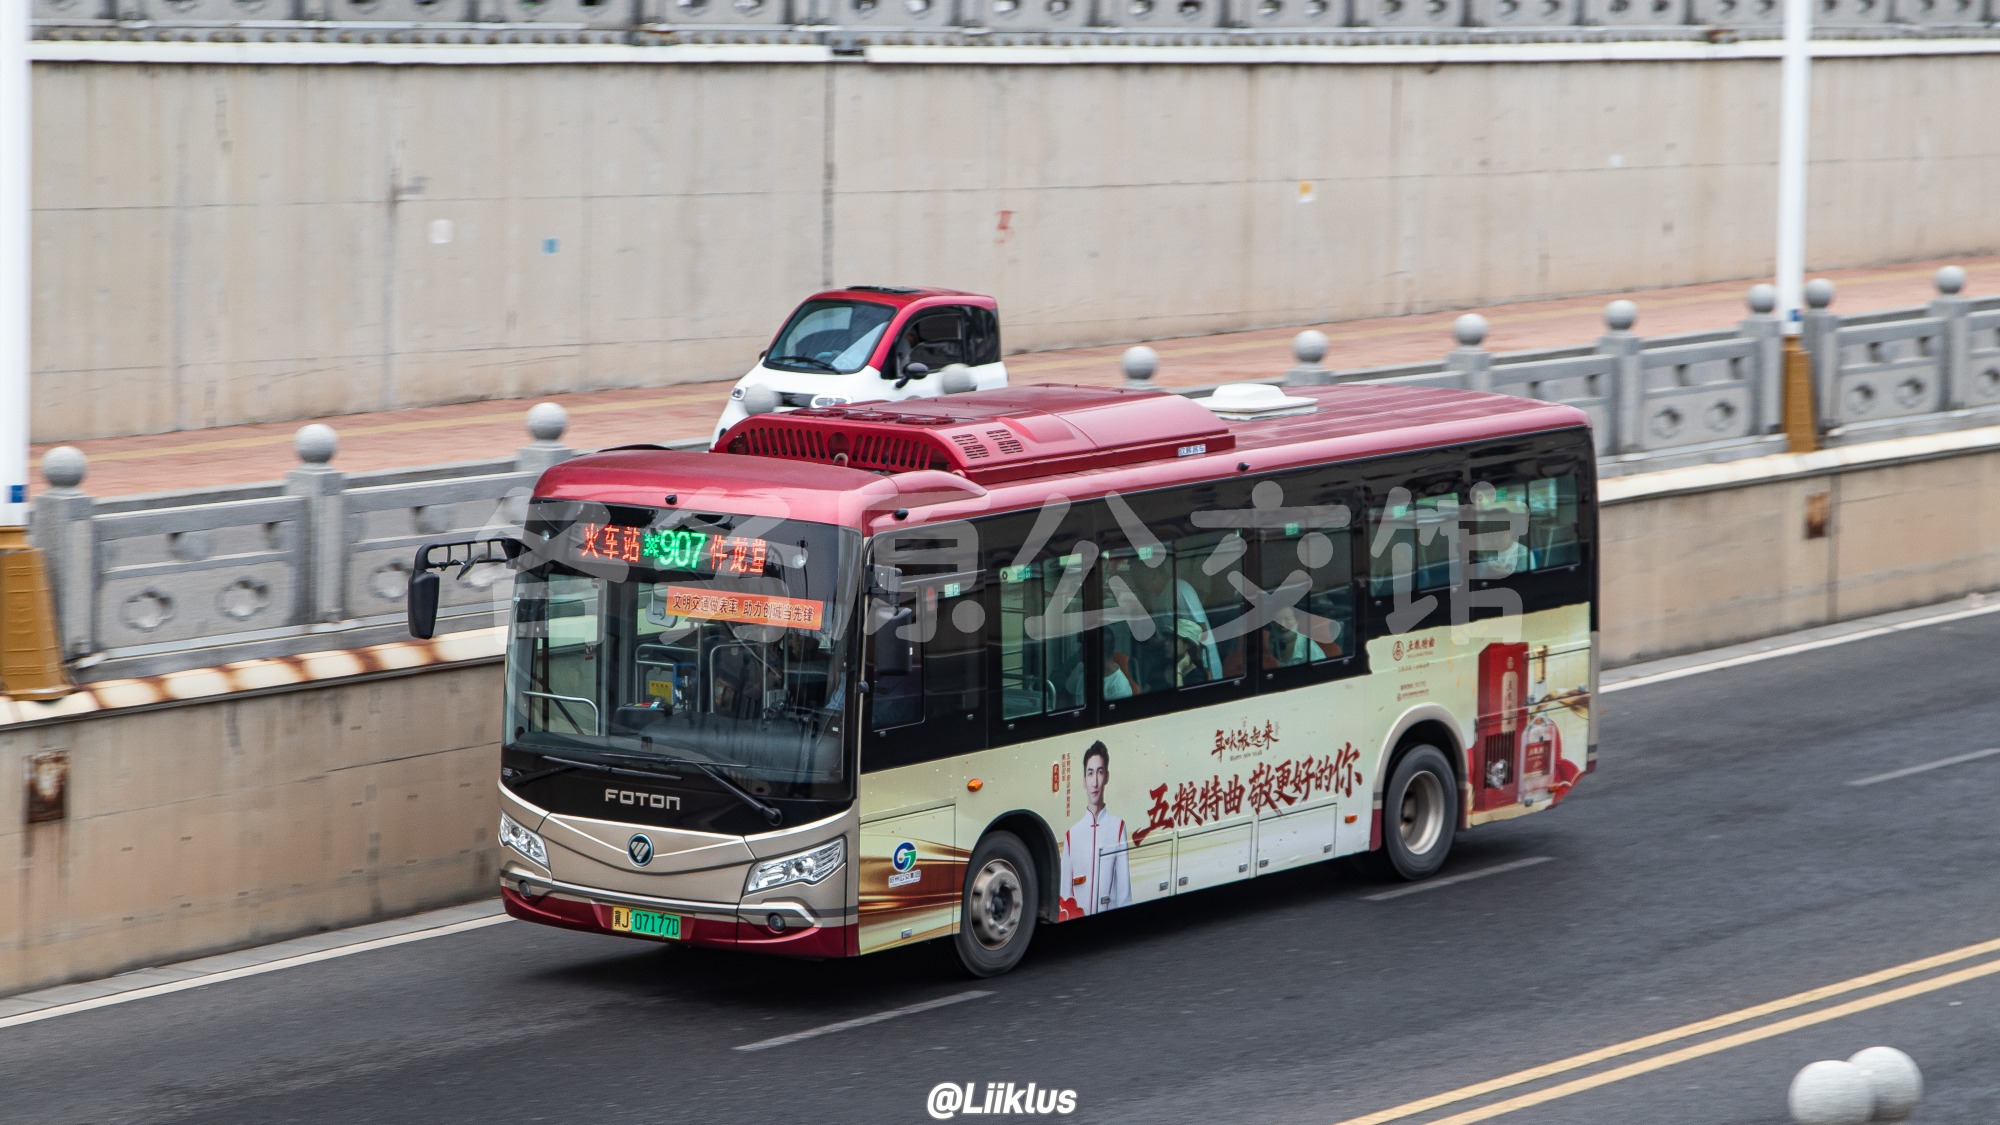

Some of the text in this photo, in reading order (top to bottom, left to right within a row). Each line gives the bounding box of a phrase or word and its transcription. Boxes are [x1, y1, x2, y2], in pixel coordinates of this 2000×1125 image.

[581, 523, 642, 563] 火车站
[658, 529, 707, 569] 907
[672, 594, 739, 615] 文明交通做表率
[604, 787, 681, 811] FOTON
